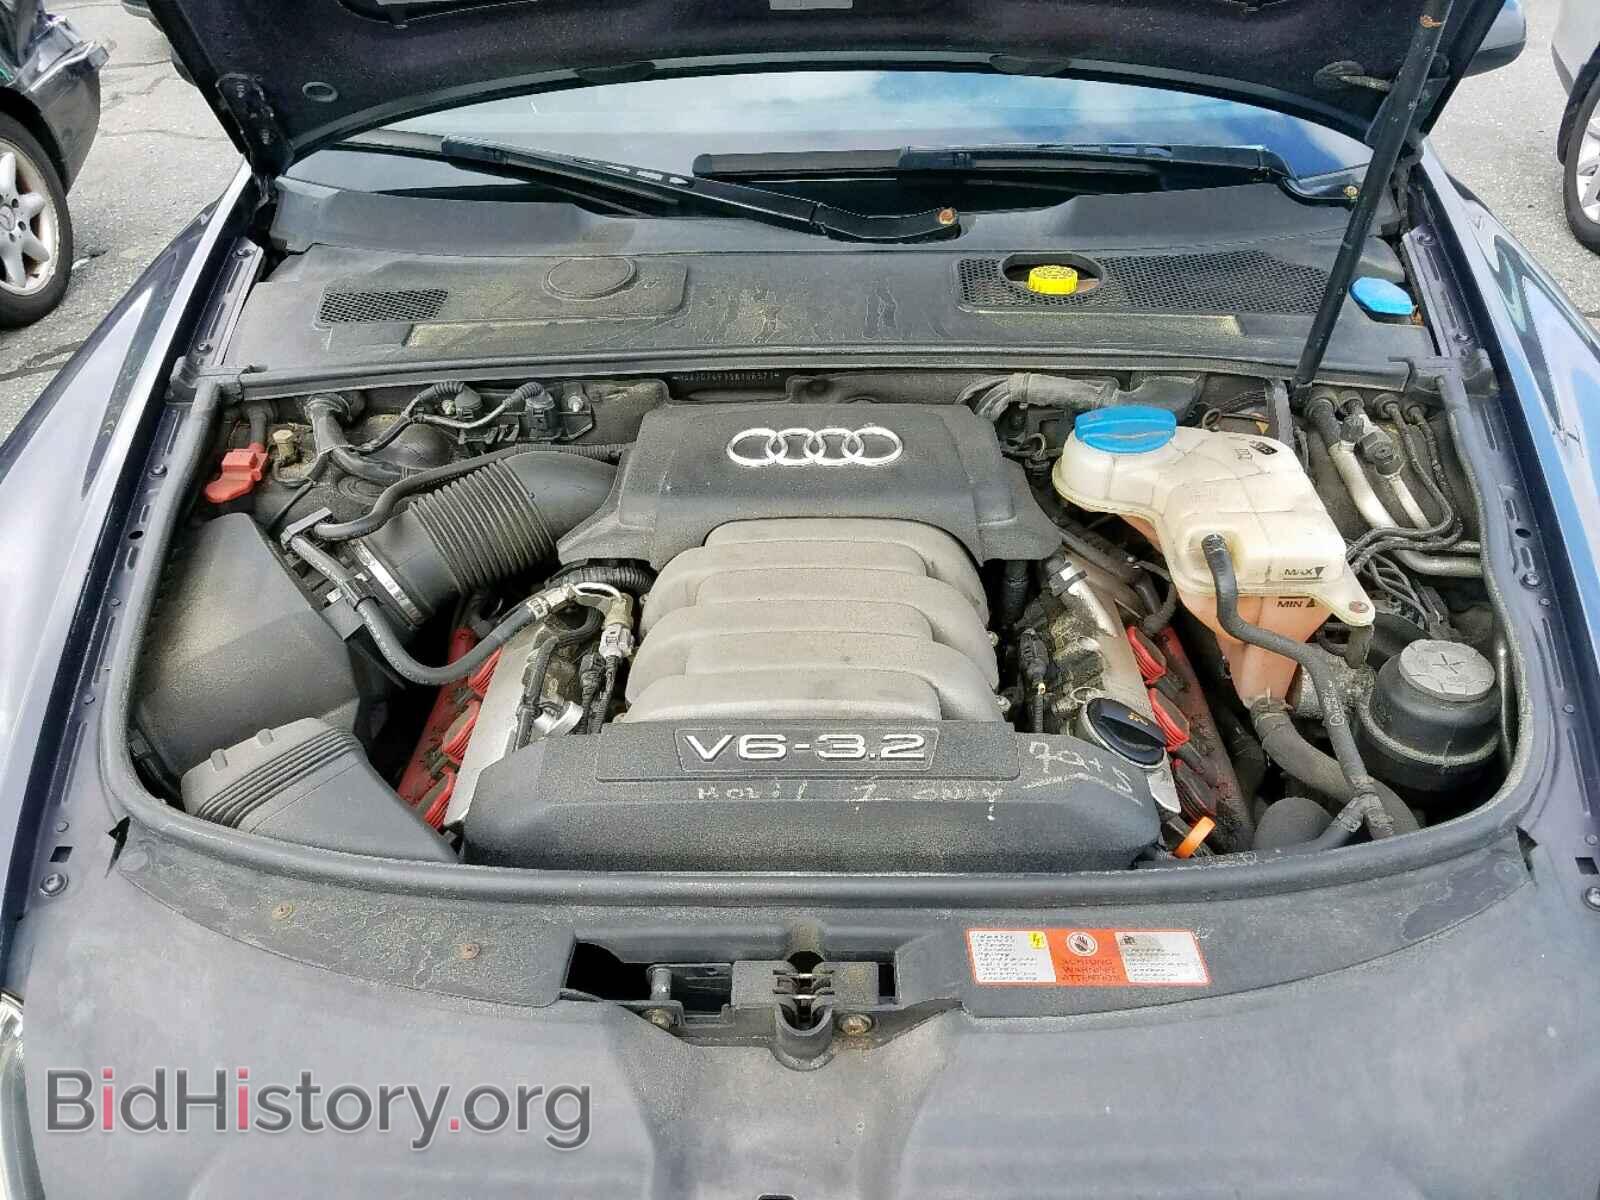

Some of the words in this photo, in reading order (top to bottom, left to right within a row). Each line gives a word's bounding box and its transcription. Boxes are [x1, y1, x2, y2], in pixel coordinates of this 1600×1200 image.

[1283, 567, 1313, 576] MAX
[1277, 600, 1302, 608] MIN
[685, 733, 926, 761] V6-3.2
